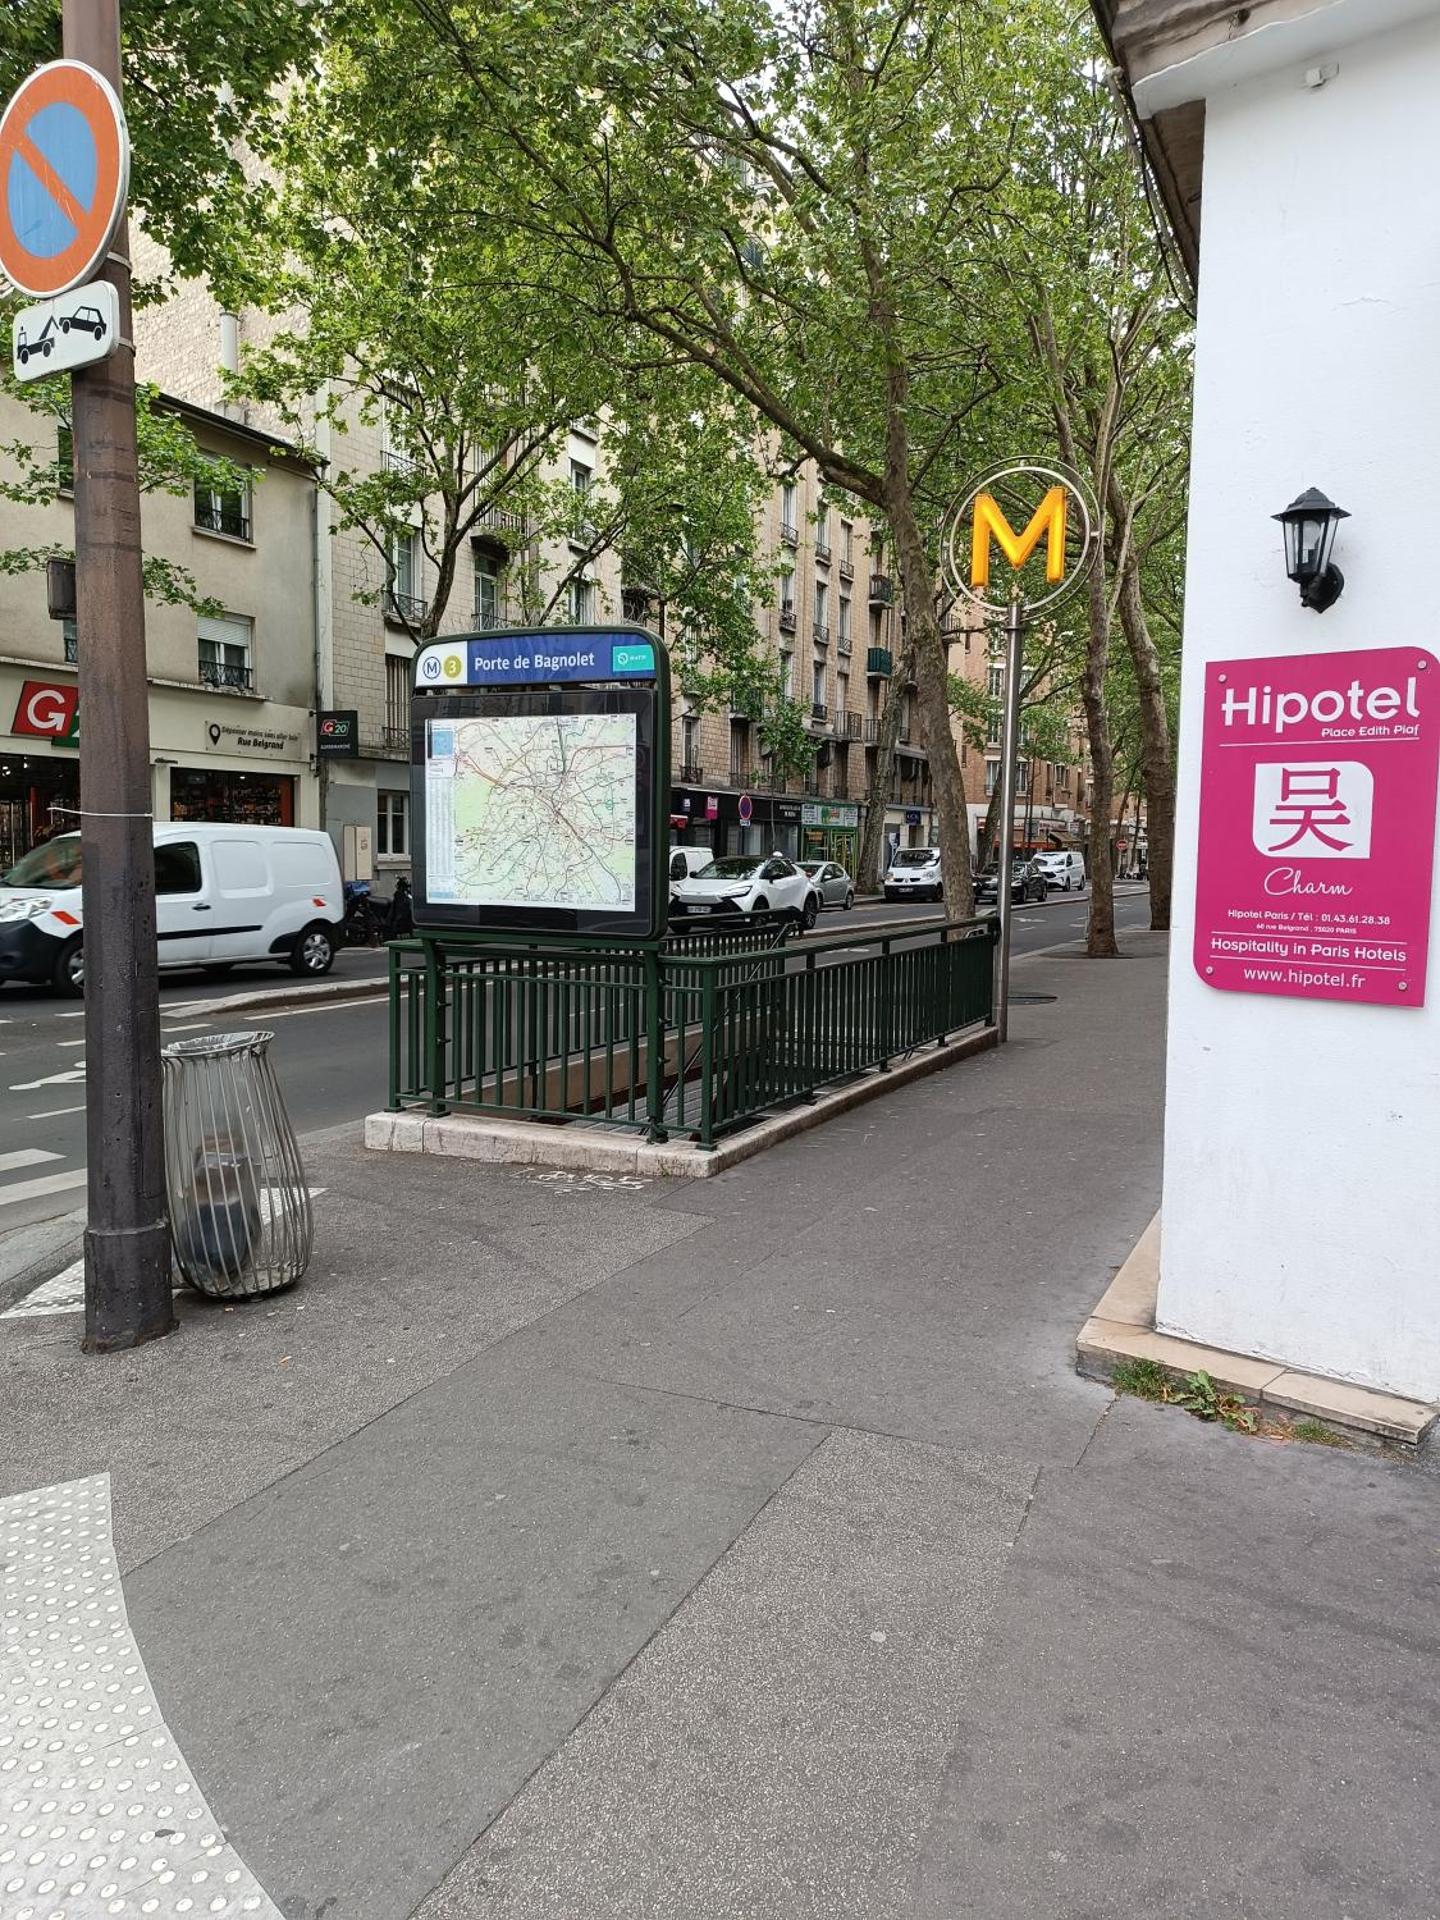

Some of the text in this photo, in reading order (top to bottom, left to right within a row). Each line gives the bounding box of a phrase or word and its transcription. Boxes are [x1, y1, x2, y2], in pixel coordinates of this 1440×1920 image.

[971, 485, 1067, 588] M
[474, 656, 510, 672] Porte
[513, 655, 530, 669] de
[534, 651, 595, 671] Bagnolet
[1221, 676, 1420, 733] Hipotel
[1321, 723, 1420, 738] Place Edith Piaf
[238, 737, 284, 750] Rue Belgrand
[1264, 867, 1352, 896] Charm
[1228, 909, 1262, 921] Hipotel
[1264, 911, 1289, 921] Paris
[1298, 911, 1313, 921] Tél
[1321, 913, 1391, 925] 01.43.61.28.38
[1211, 938, 1406, 962] Hospitality in Paris Hotels
[1244, 967, 1366, 988] www.hipotel.fr
